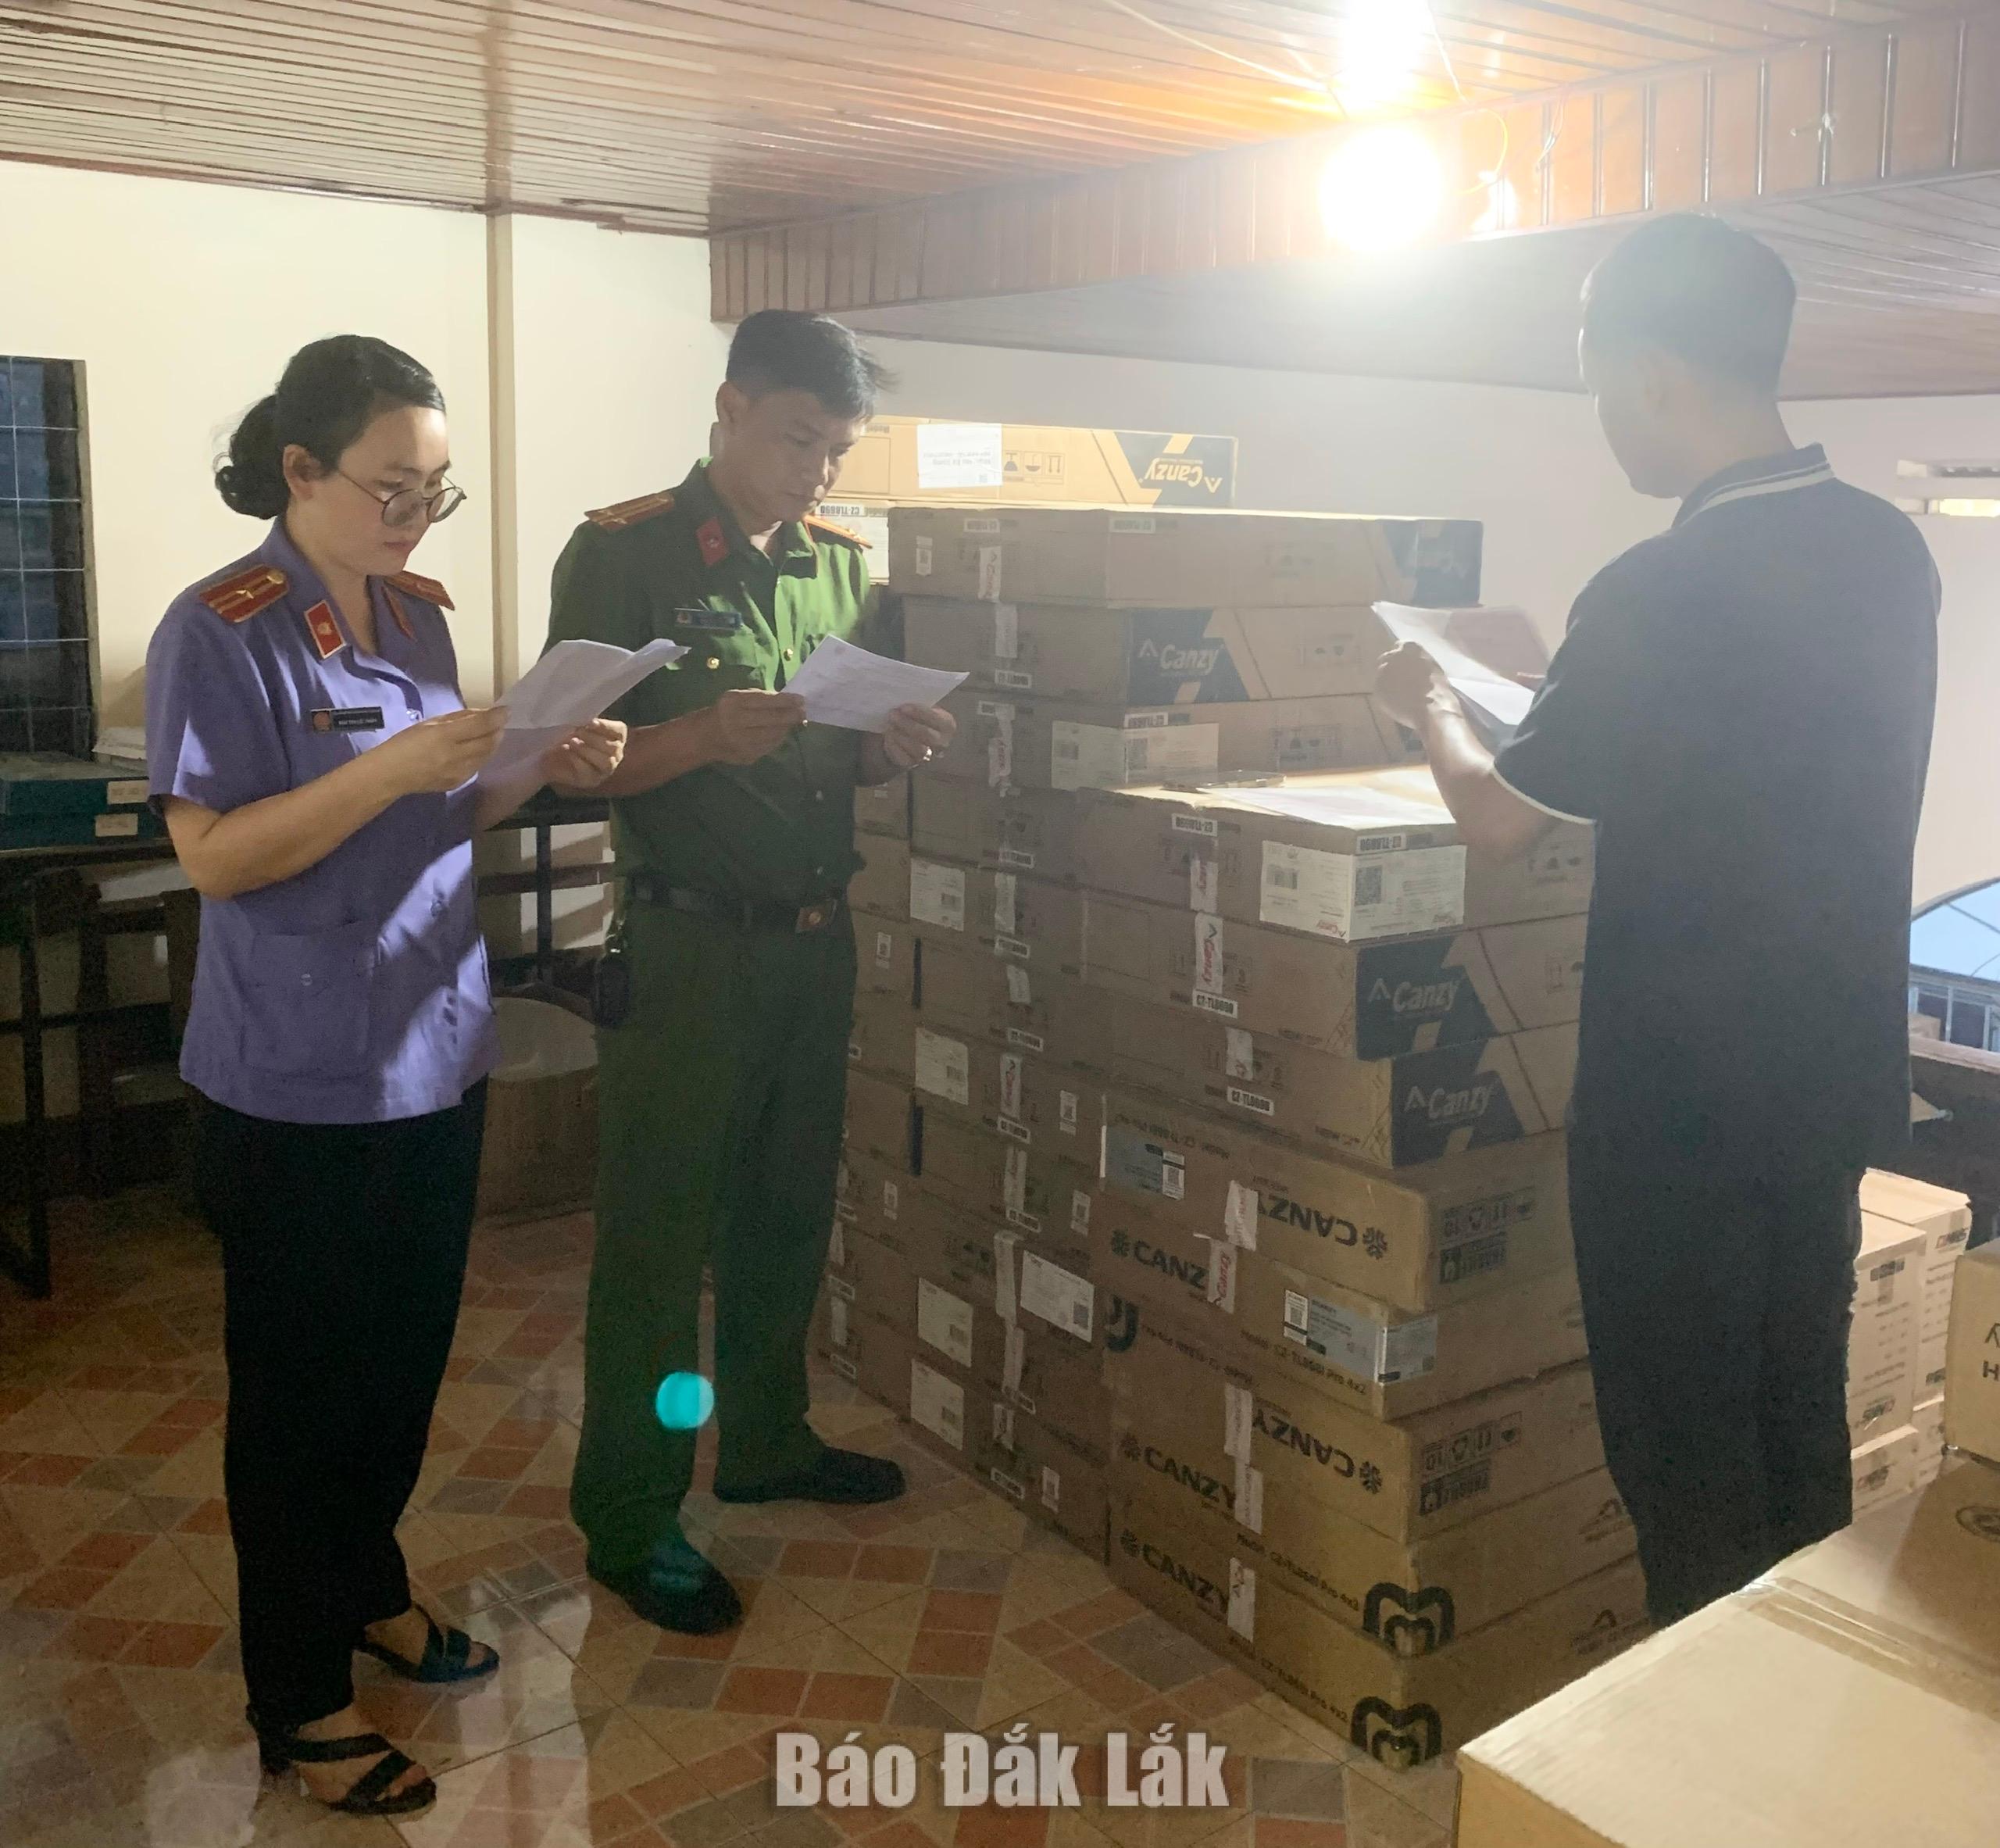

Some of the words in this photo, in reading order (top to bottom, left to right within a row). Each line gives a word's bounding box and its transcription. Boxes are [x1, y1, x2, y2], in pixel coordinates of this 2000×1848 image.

[1144, 457, 1203, 488] Canzy
[1160, 643, 1224, 675] Canzy
[1392, 980, 1460, 1013] Canzy
[1428, 1083, 1495, 1119] Canzy
[1134, 1239, 1209, 1290] CANZ
[1252, 1408, 1355, 1478] CANZY
[1143, 1446, 1236, 1510] CANZY
[1142, 1543, 1230, 1615] CANZY
